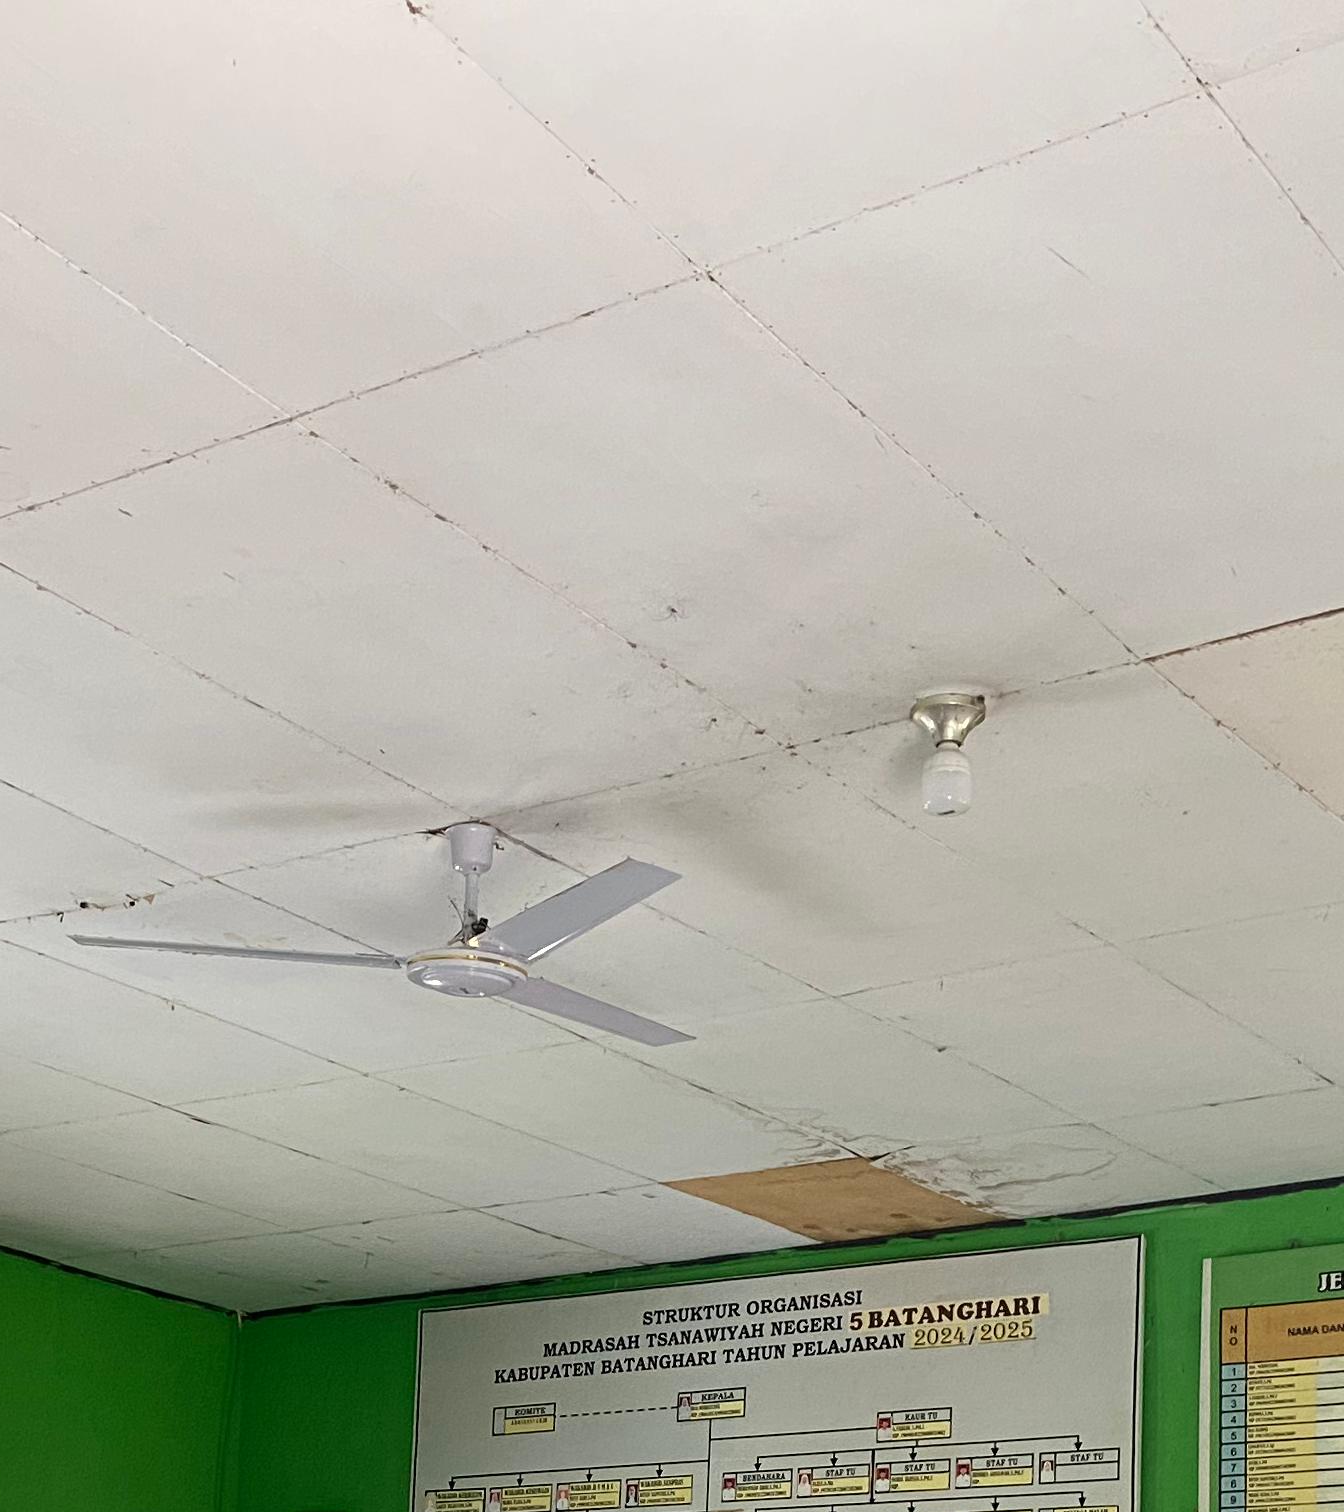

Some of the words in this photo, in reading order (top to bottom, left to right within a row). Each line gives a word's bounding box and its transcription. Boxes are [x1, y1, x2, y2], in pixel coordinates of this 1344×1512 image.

[642, 1302, 740, 1325] STRUKTUR
[747, 1290, 862, 1315] ORGANISASI
[543, 1334, 640, 1357] MADRASAH
[646, 1323, 764, 1348] TSANAWIYAH
[770, 1315, 843, 1336] NEGERI
[849, 1312, 863, 1331] 5
[868, 1296, 1041, 1329] BATANGHARI
[1287, 1325, 1320, 1337] NAMA
[1321, 1323, 1344, 1333] DAN
[494, 1360, 596, 1384] KABUPATEN
[600, 1350, 717, 1374] BATANGHARI
[722, 1343, 786, 1364] TAHUN
[791, 1333, 906, 1358] PELAJARAN
[914, 1320, 1034, 1347] 2024/2025
[701, 1391, 735, 1401] KEPALA
[514, 1406, 547, 1416] KOMITE
